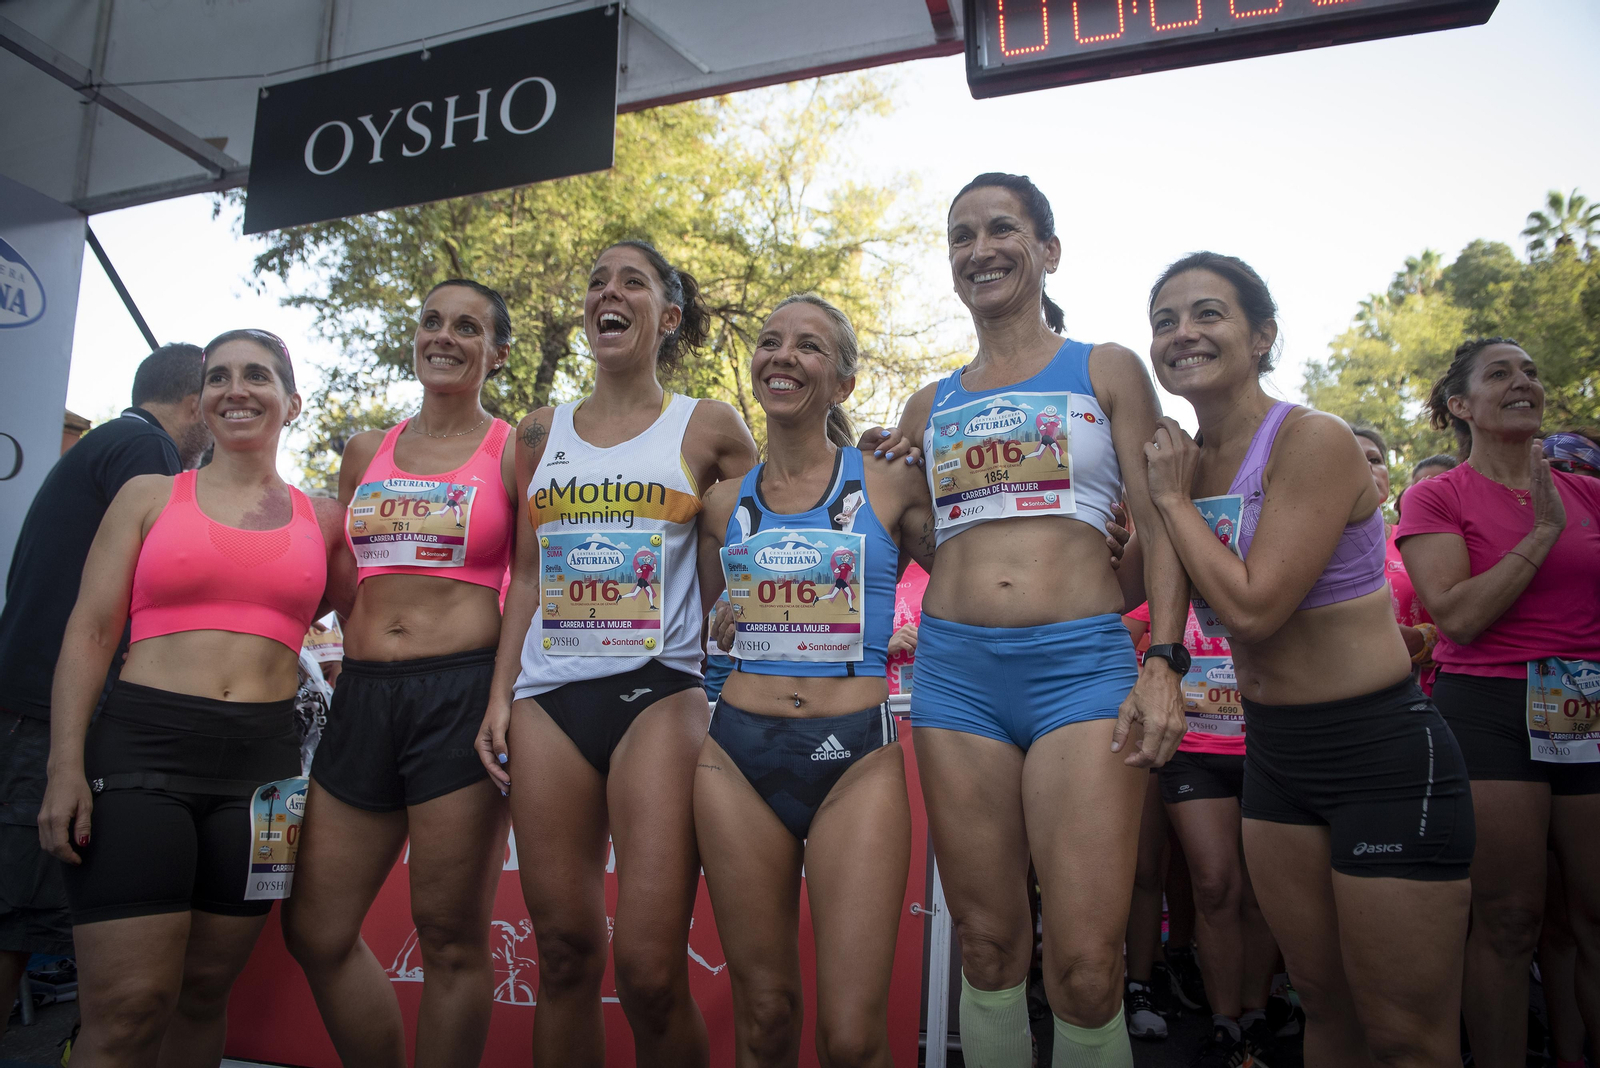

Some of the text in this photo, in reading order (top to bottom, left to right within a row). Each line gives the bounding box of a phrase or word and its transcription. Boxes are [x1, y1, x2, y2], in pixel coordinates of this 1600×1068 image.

[304, 76, 557, 176] OYSHO
[966, 415, 1022, 434] ASTURIANA
[965, 440, 1023, 470] 016
[984, 470, 1009, 484] 1854
[386, 479, 437, 489] ASTURIANA
[535, 474, 666, 509] eMotion
[961, 483, 1039, 500] CARRERA DE LA MUJER
[379, 499, 431, 518] 016
[560, 506, 634, 528] running
[392, 521, 410, 531] 781
[369, 535, 394, 543] CARRERA
[413, 533, 438, 542] MUJER
[728, 547, 749, 556] SUMA
[570, 553, 621, 566] ASTURIANA
[759, 552, 818, 565] ASTURIANA
[569, 580, 620, 602] 016
[757, 580, 817, 604] 016
[589, 607, 596, 618] 2
[783, 609, 789, 621] 1
[560, 620, 584, 628] CARRERA
[745, 623, 831, 632] CARRERA DE LA MUJER
[550, 636, 580, 647] OYSHO
[808, 642, 851, 651] Santander
[1209, 671, 1235, 679] ASTURI
[1217, 706, 1238, 714] 4690
[811, 750, 851, 761] adidas
[1537, 745, 1571, 756] OYSHO
